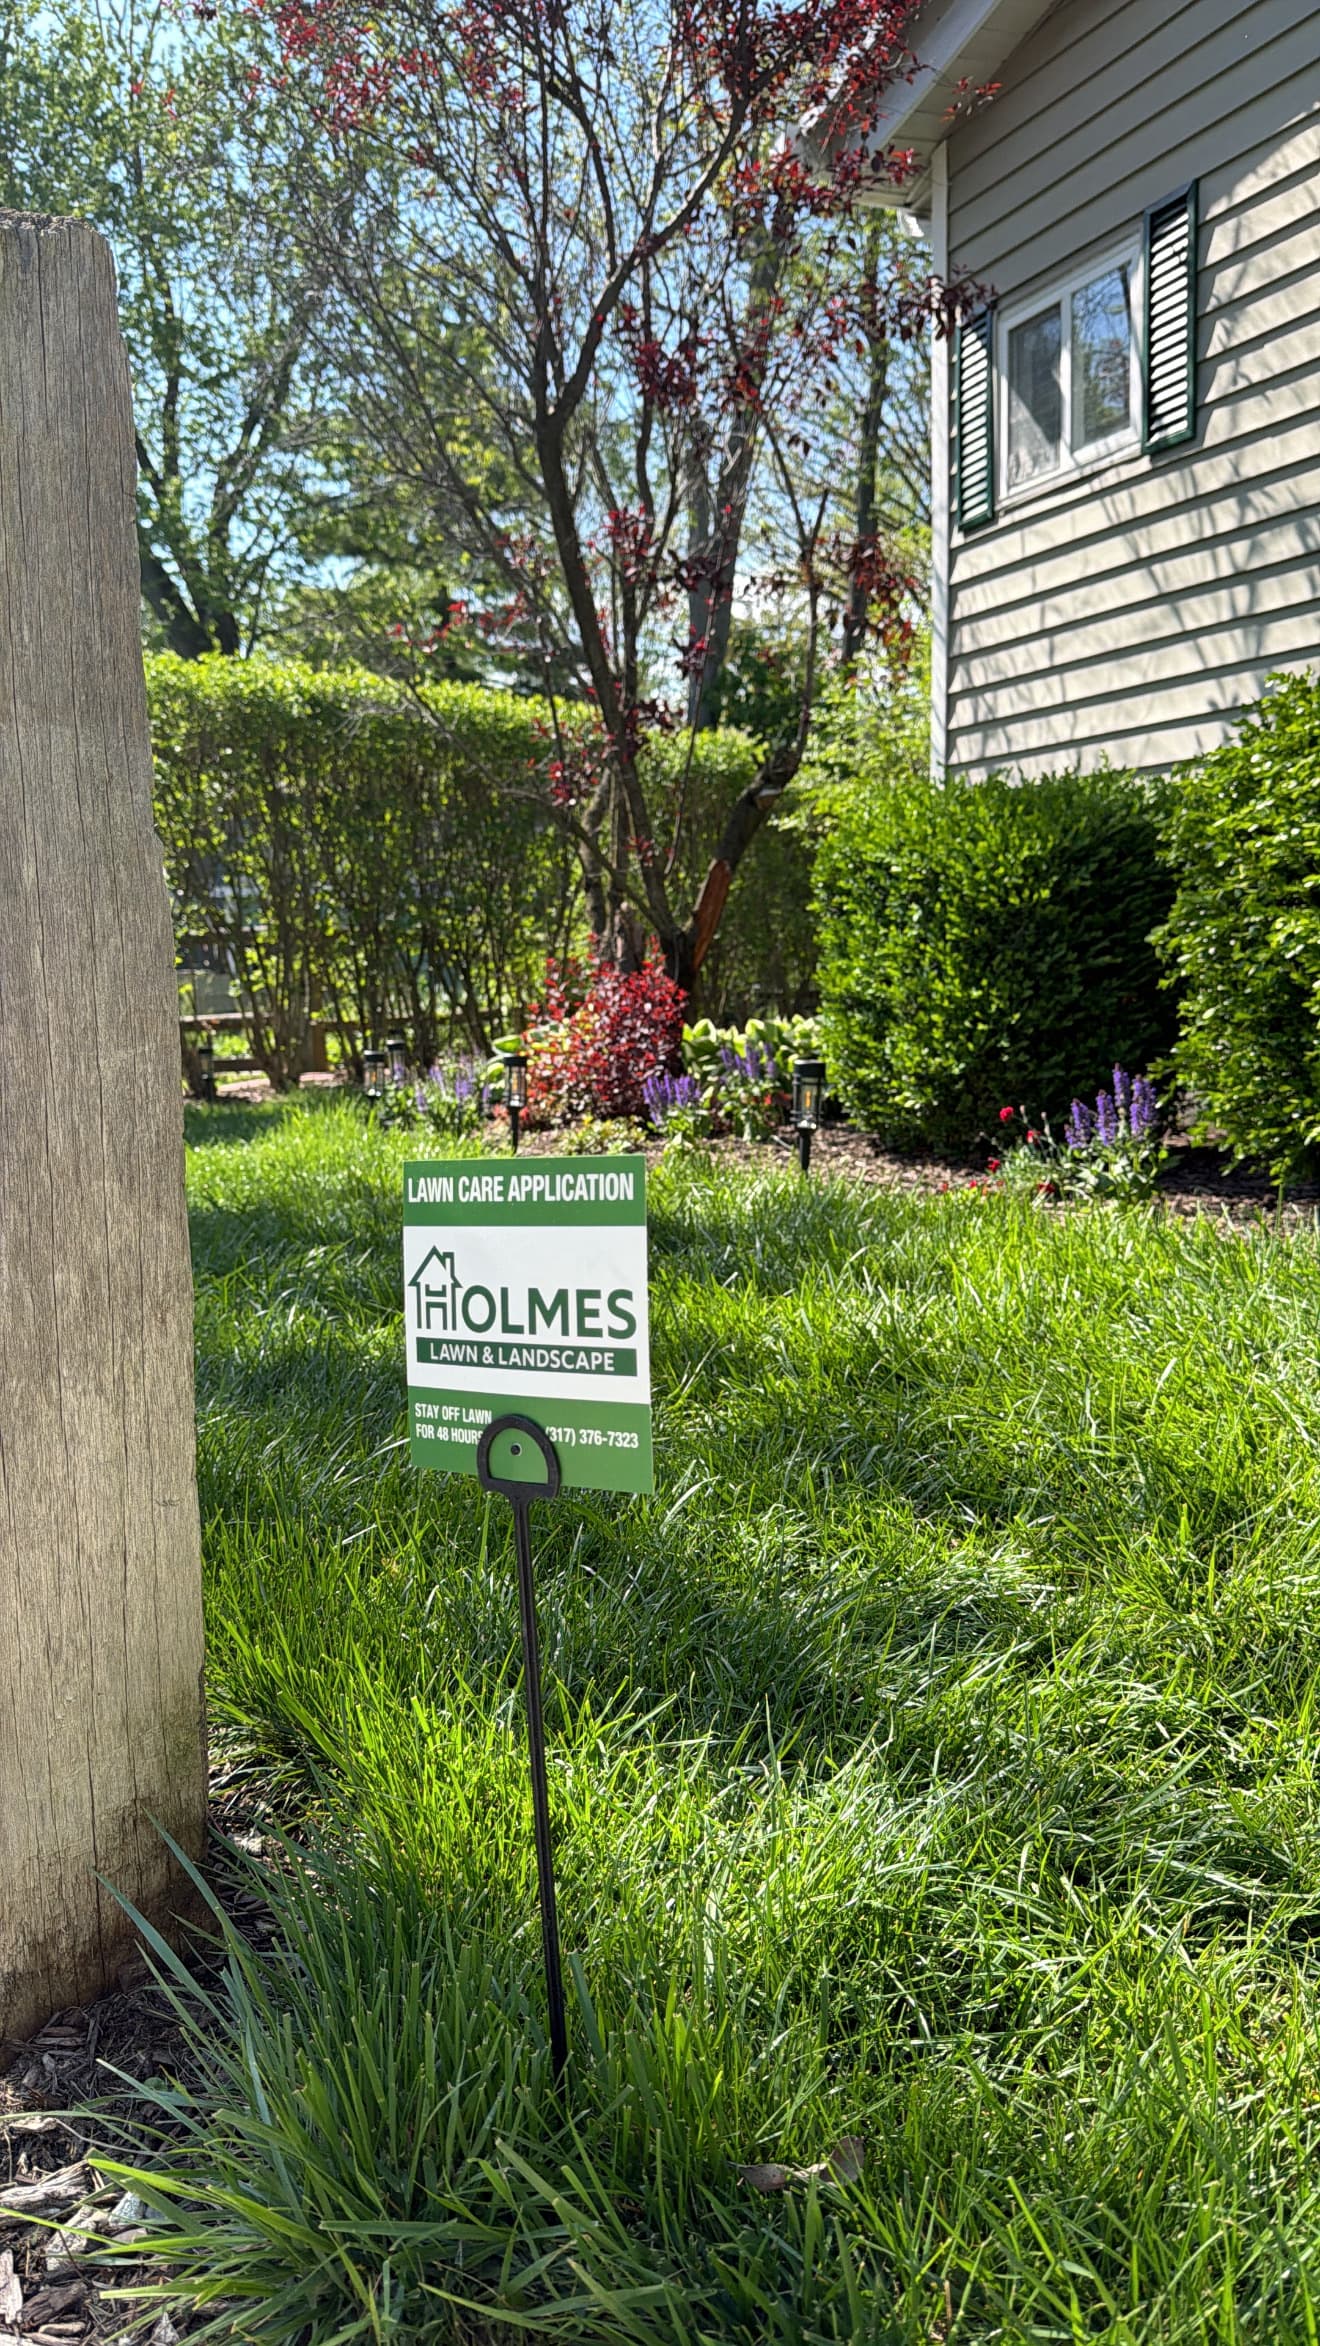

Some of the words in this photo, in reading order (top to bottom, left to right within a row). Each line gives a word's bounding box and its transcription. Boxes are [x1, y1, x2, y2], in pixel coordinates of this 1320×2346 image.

[407, 1177, 454, 1203] LAWN
[458, 1175, 504, 1202] CARE
[507, 1172, 634, 1202] APPLICATION
[413, 1282, 638, 1340] HOLMES
[430, 1342, 479, 1364] LAWN
[482, 1346, 495, 1365] &
[499, 1347, 615, 1372] LANDSCAPE
[414, 1402, 439, 1420] STAY
[442, 1405, 461, 1422] OFF
[463, 1408, 493, 1425] LAWN
[415, 1423, 435, 1440] FOR
[437, 1426, 449, 1441] 48
[579, 1429, 640, 1449] 376-7323
